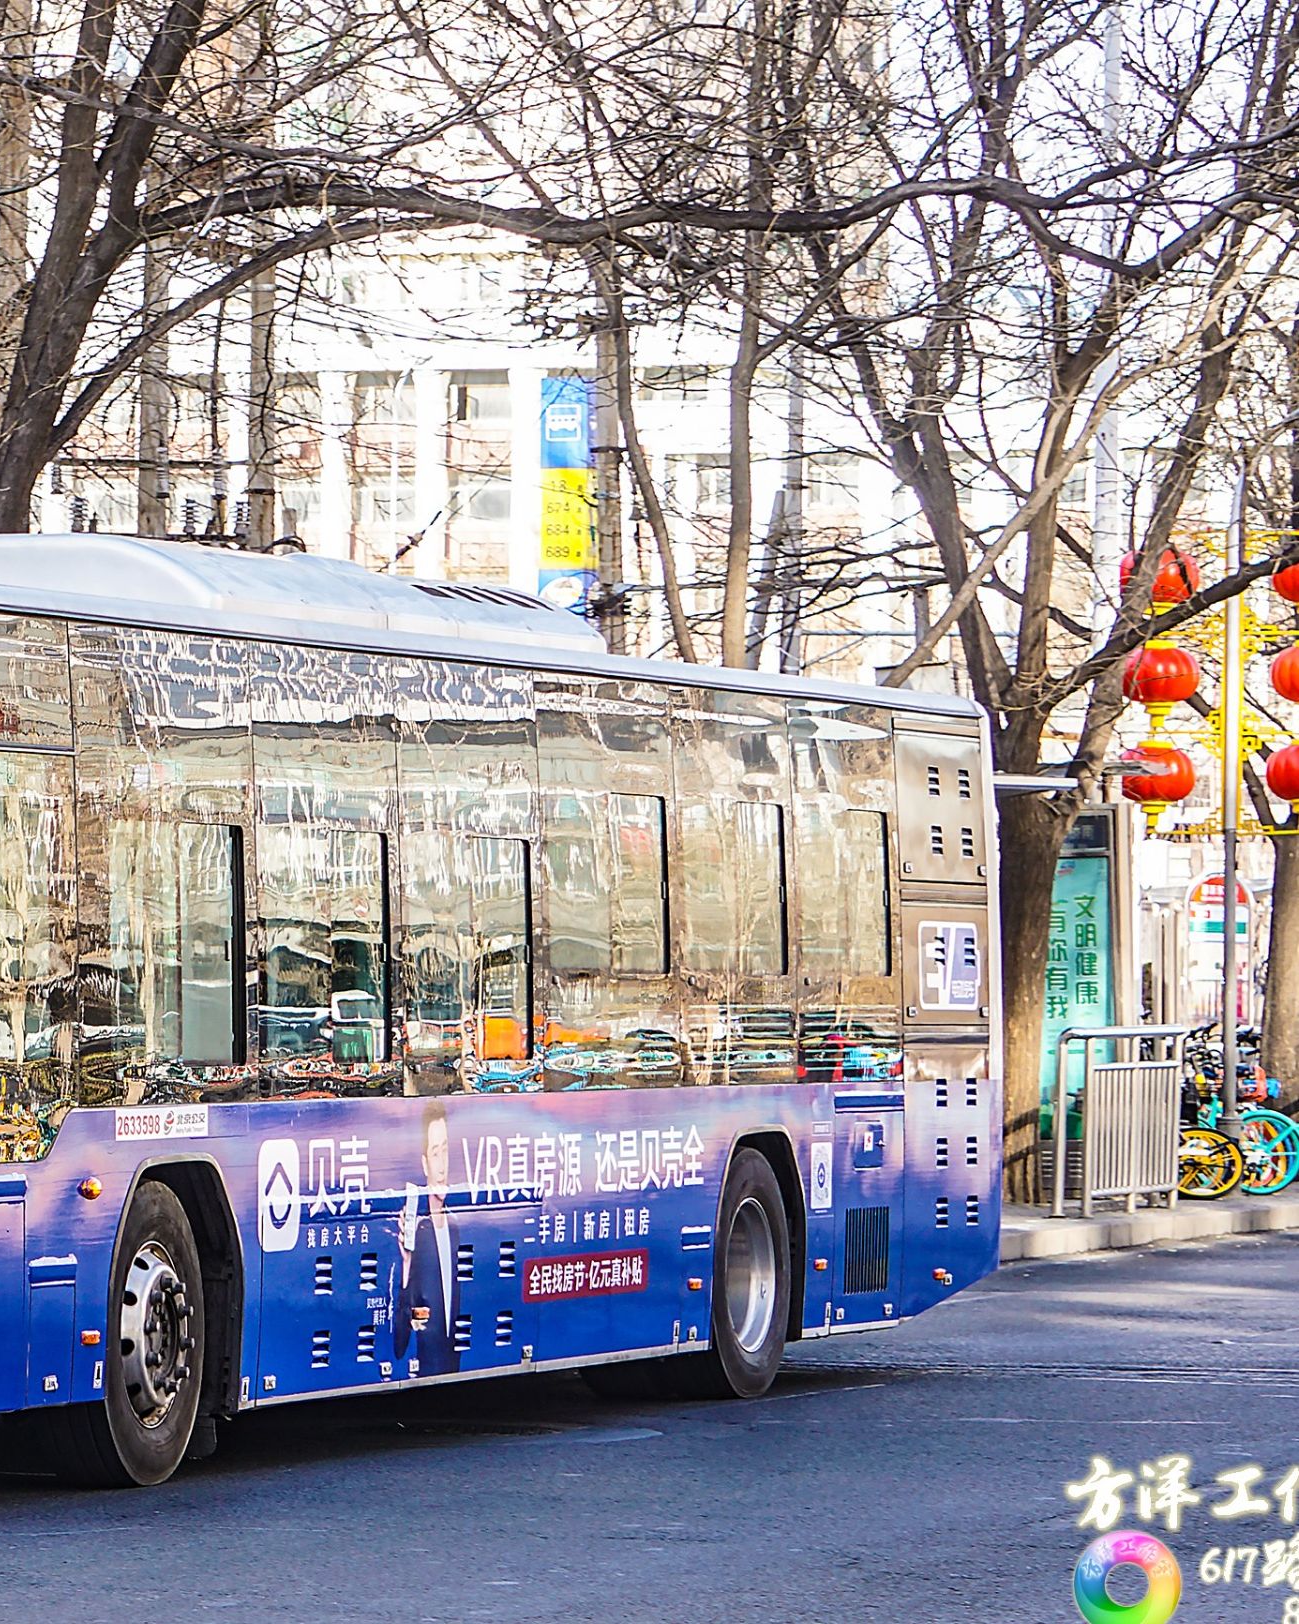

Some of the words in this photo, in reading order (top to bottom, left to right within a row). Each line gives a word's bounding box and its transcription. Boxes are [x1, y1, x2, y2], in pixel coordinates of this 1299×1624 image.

[546, 546, 570, 557] 689
[1074, 895, 1099, 1005] 文明健康
[117, 1114, 161, 1136] 2633598
[308, 1135, 372, 1218] 贝壳
[462, 1132, 582, 1205] VR真房源
[595, 1124, 705, 1194] 还是贝壳全
[307, 1224, 370, 1249] 找房大平台
